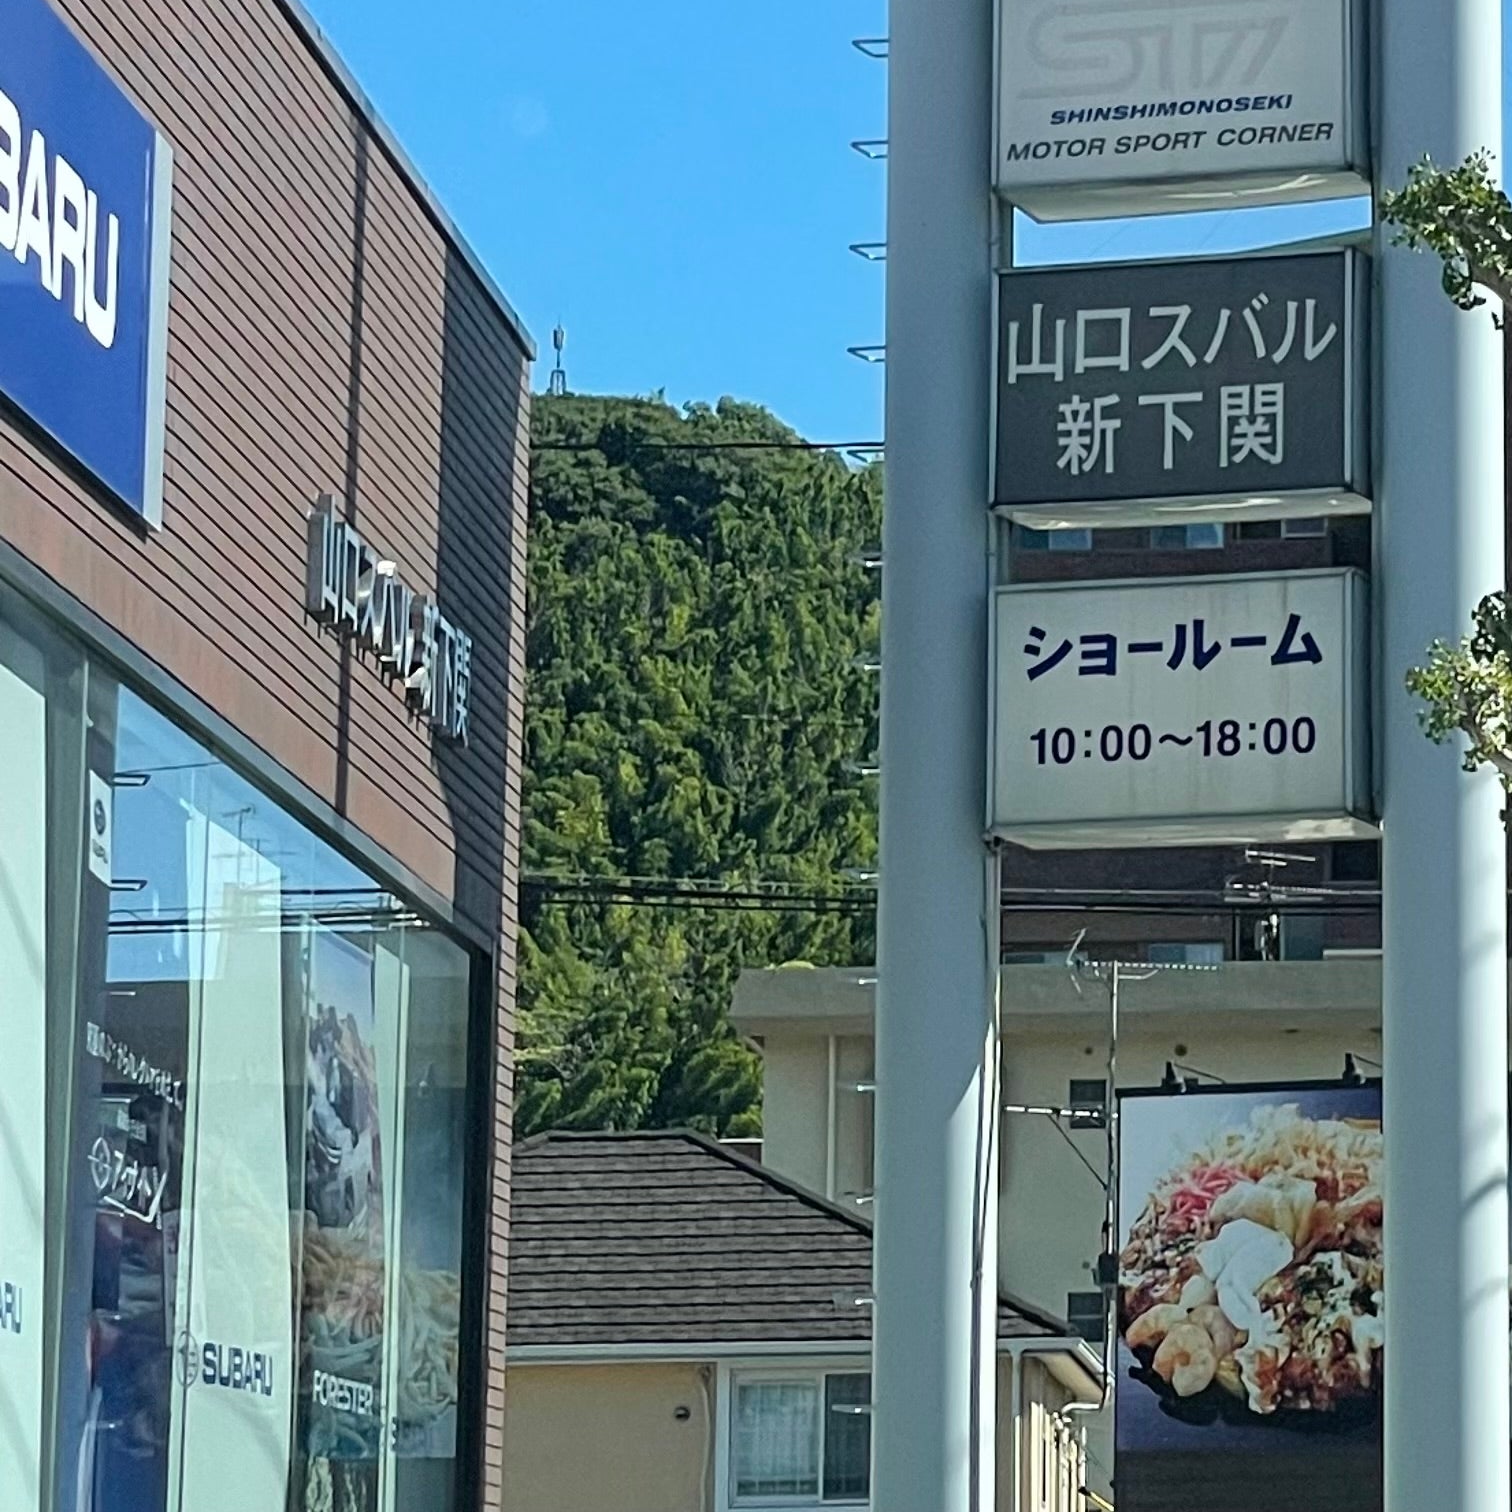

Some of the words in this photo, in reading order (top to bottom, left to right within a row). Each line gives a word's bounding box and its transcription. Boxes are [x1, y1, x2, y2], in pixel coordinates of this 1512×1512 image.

[1050, 94, 1293, 126] SHINSHIMONOSEKI
[1006, 138, 1106, 162] MOTOR
[1113, 131, 1207, 155] SPORT
[1216, 122, 1334, 147] CORNER
[1007, 291, 1338, 385] 山口スバル
[1055, 381, 1285, 476] 新下関
[1024, 613, 1323, 682] ショールーム
[202, 1341, 273, 1397] SUBARU
[312, 1369, 374, 1416] FORESTER
